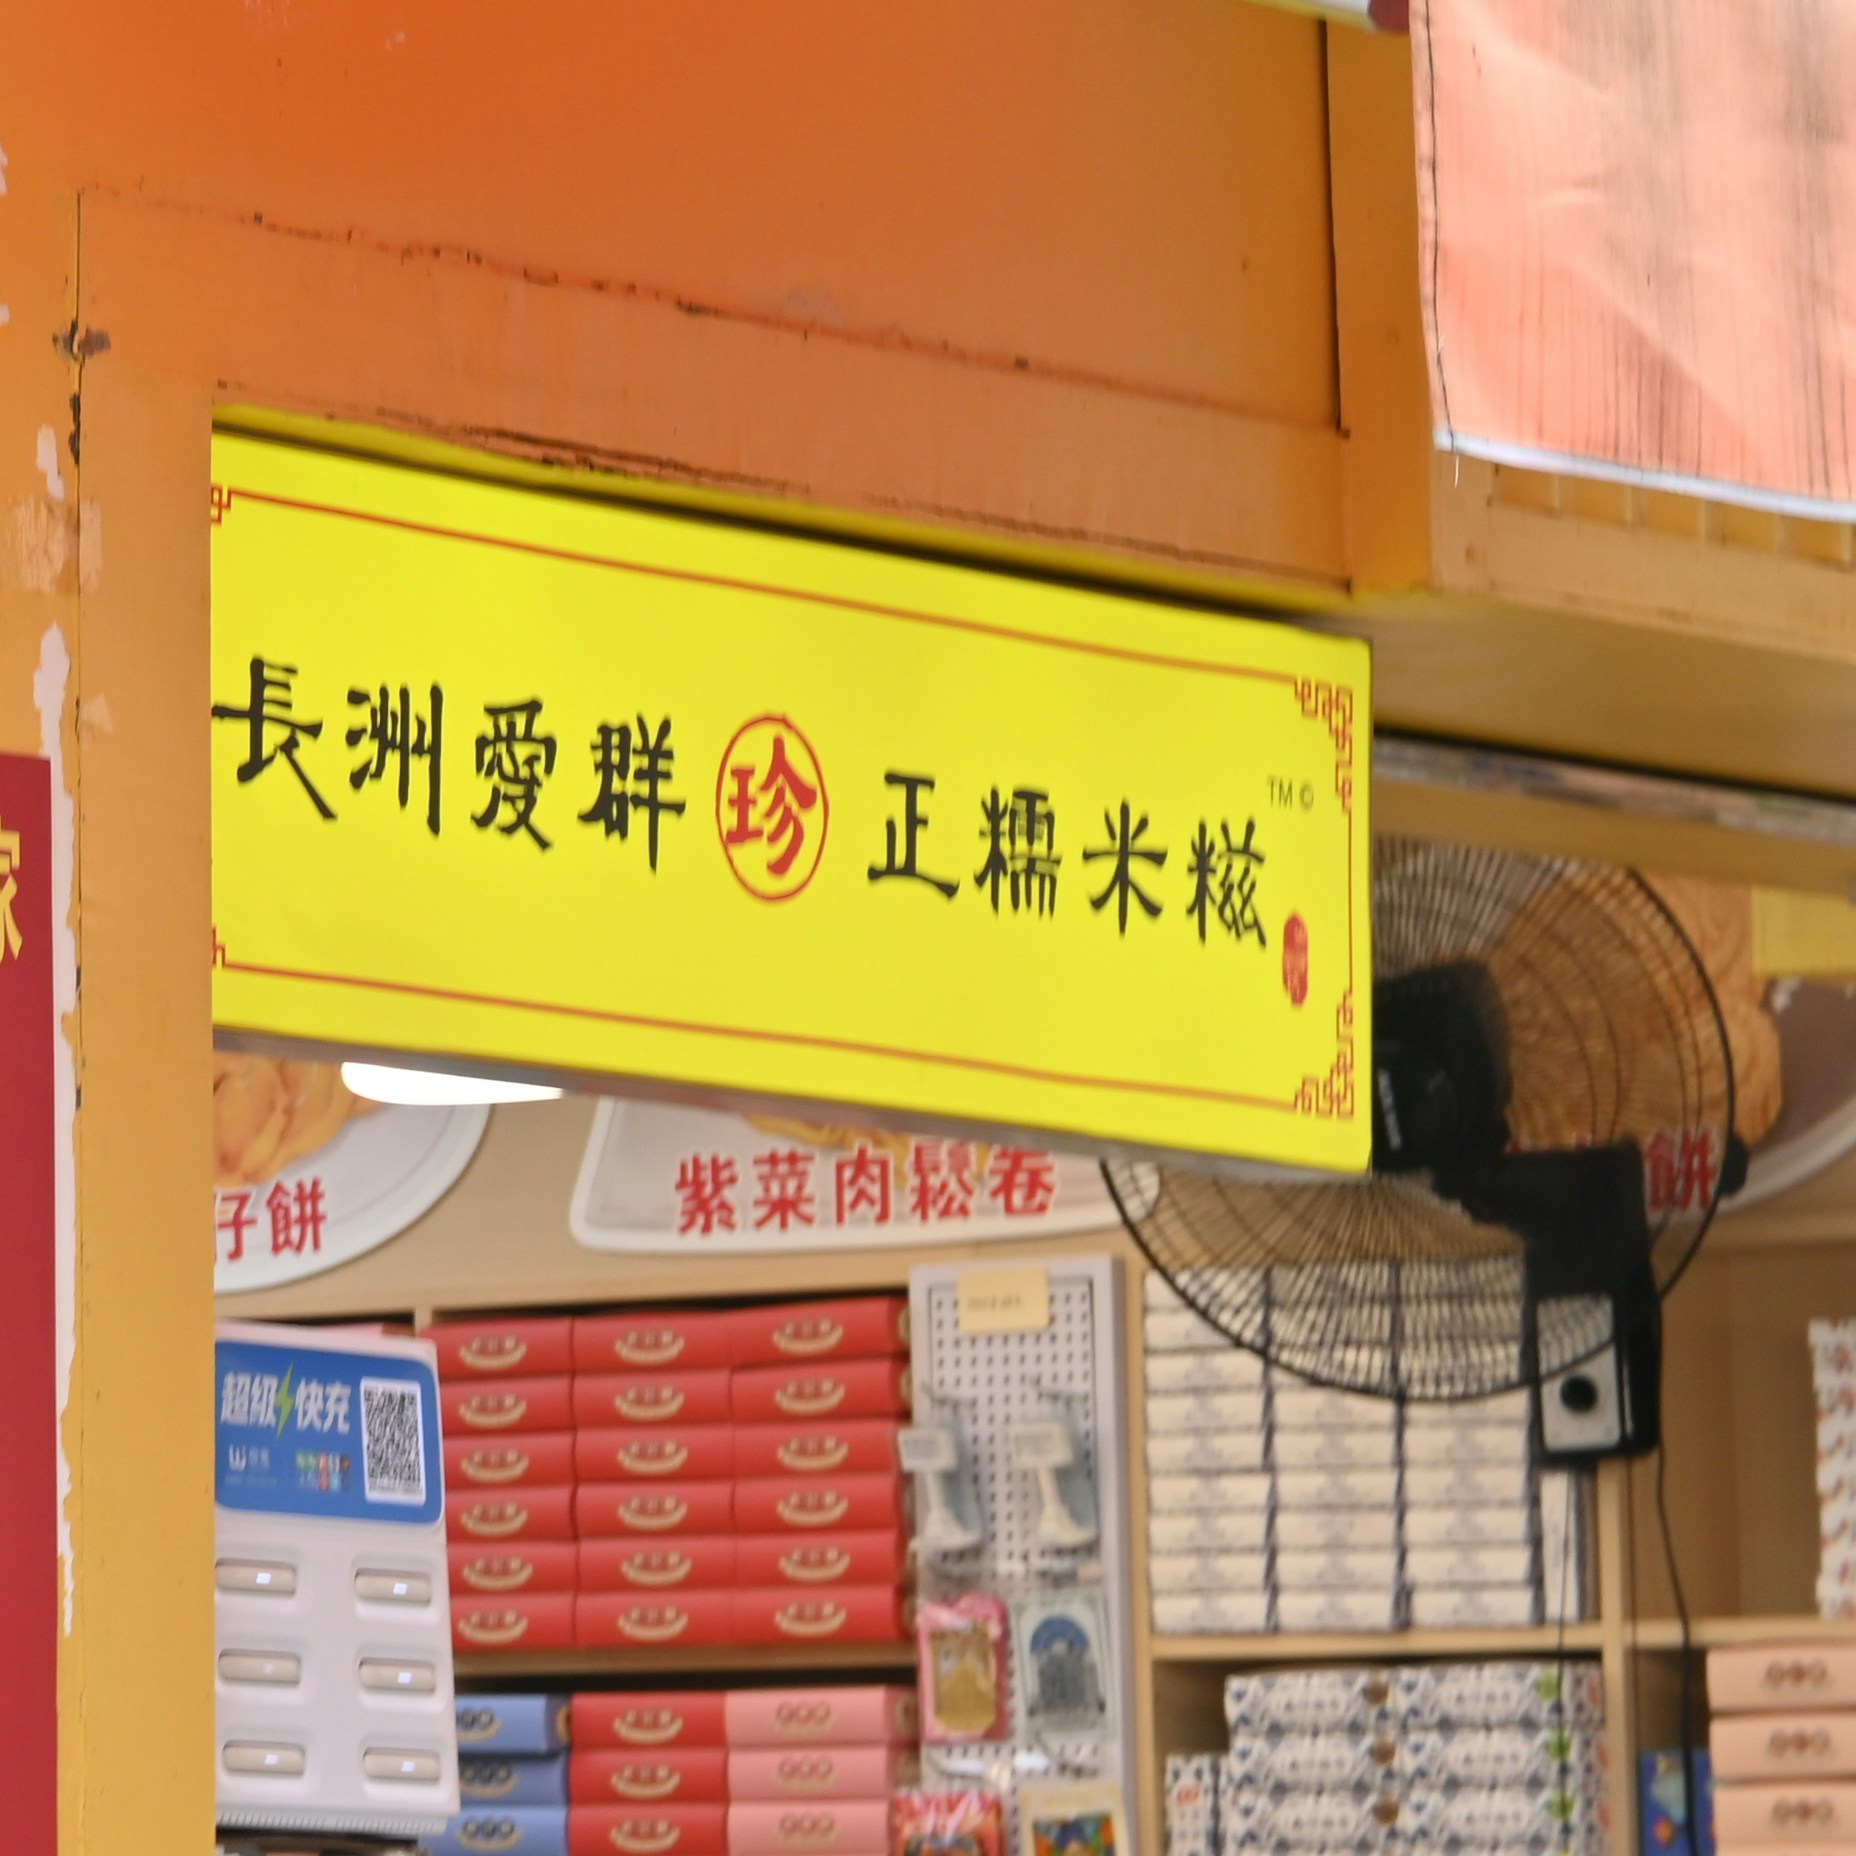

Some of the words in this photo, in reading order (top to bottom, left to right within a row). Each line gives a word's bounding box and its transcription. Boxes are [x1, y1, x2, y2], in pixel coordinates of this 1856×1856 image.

[213, 657, 686, 874] 長洲愛群
[725, 734, 818, 876] 珍
[867, 770, 1267, 948] 正糯米糍
[1266, 775, 1294, 808] TM
[675, 1142, 1056, 1236] 紫菜肉鬆卷
